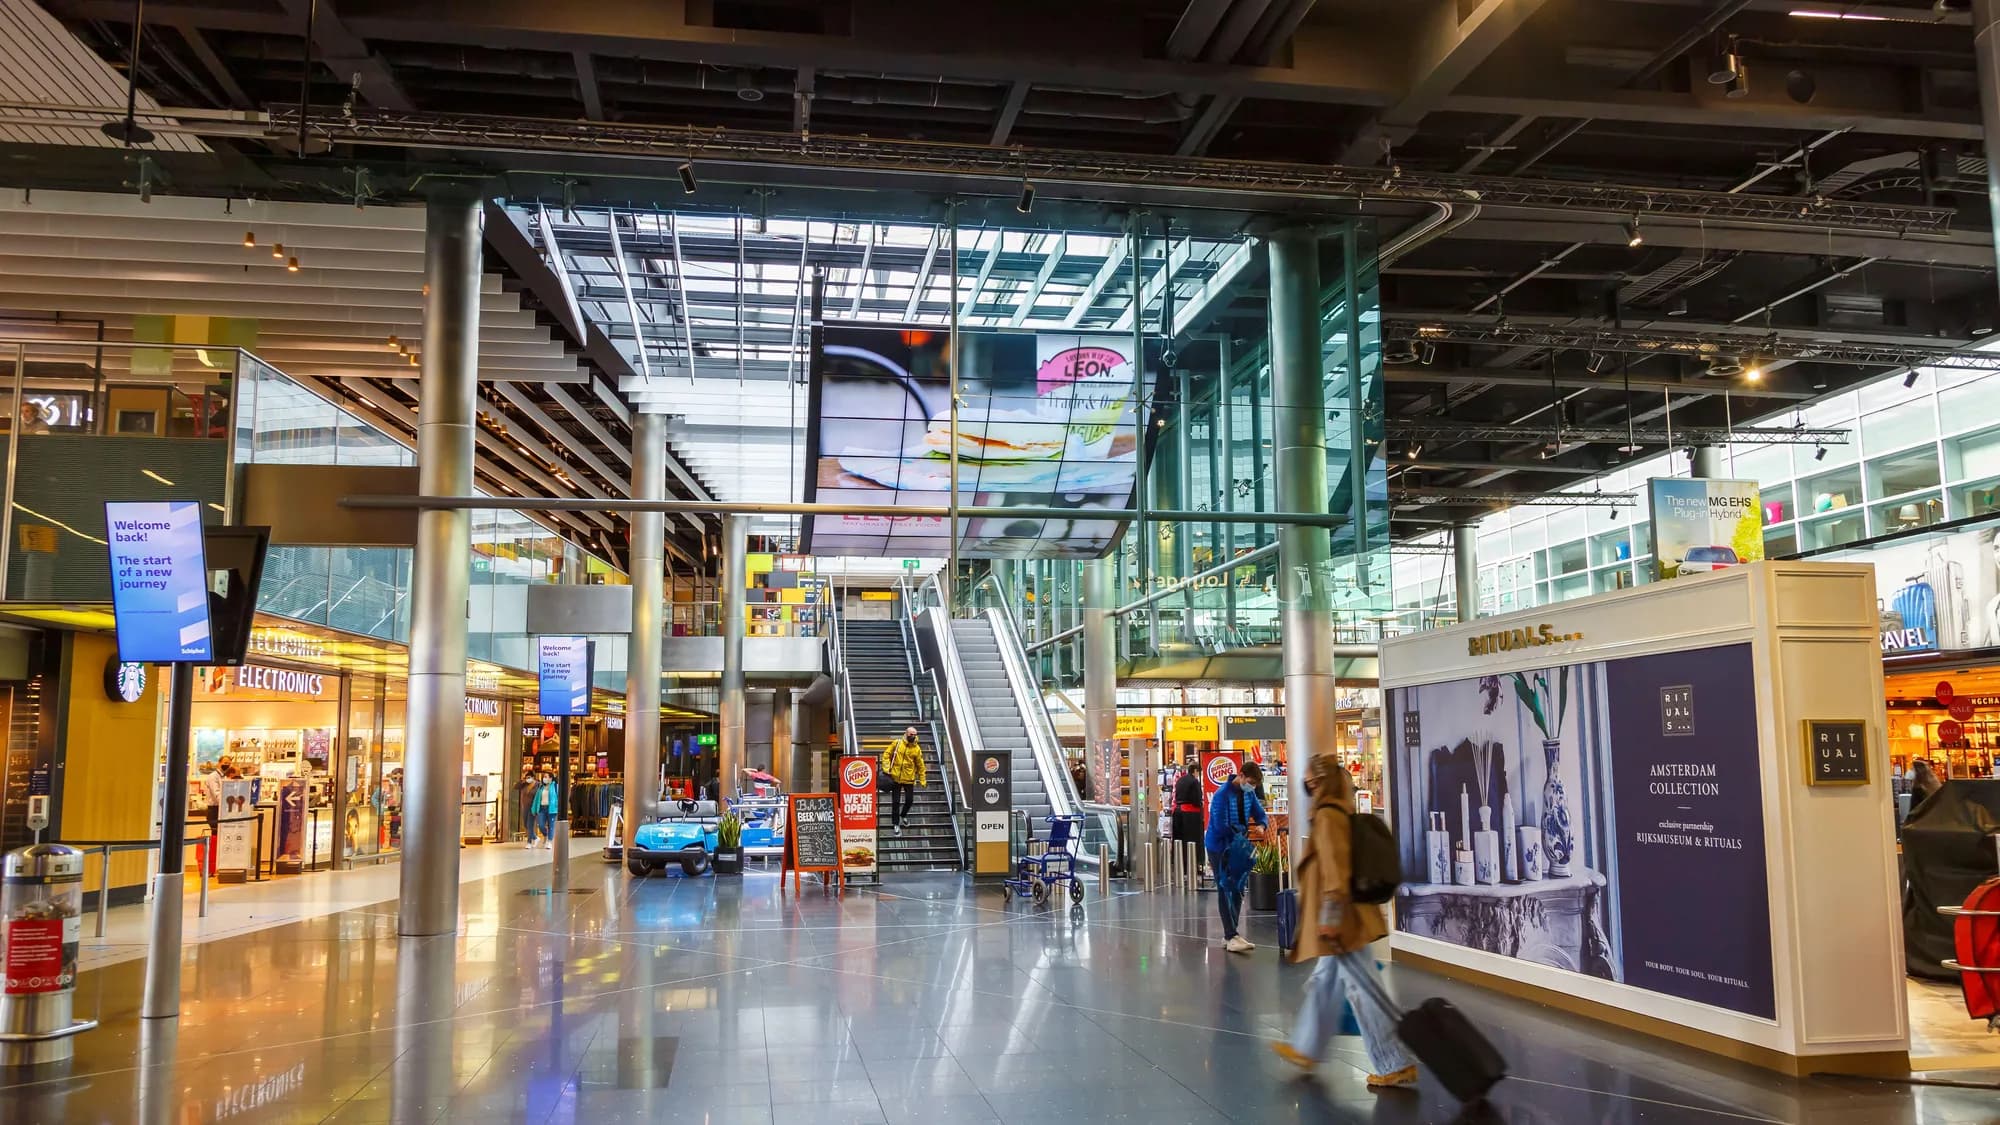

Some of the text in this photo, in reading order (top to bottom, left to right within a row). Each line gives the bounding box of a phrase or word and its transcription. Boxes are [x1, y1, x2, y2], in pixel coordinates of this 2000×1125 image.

[1664, 495, 1752, 507] The new MG EHS
[1673, 507, 1742, 520] Plug-in Hybrid
[114, 520, 171, 530] Welcome
[116, 532, 148, 542] back!
[118, 556, 172, 565] The start
[119, 567, 172, 577] of a new
[119, 579, 167, 590] journey
[239, 665, 323, 696] ELECTRONICS
[1969, 697, 2000, 705] NGCHA
[1951, 705, 1971, 713] SALE
[1210, 762, 1233, 772] BURGER
[1649, 764, 1716, 777] AMSTERDAM
[849, 771, 869, 782] KING
[1211, 768, 1233, 779] KING
[1649, 782, 1719, 796] COLLECTION
[843, 793, 873, 804] WE'RE
[844, 804, 872, 814] OPEN!
[1658, 820, 1714, 833] exclusive partnership
[1636, 832, 1742, 850] RIJKSMUSEUM & RITUALS
[1645, 960, 1659, 969] YOUR
[1675, 967, 1690, 976] YOUR
[1691, 970, 1707, 979] SOUL.
[1707, 974, 1723, 983] YOUR
[1724, 977, 1750, 988] RITUALS.
